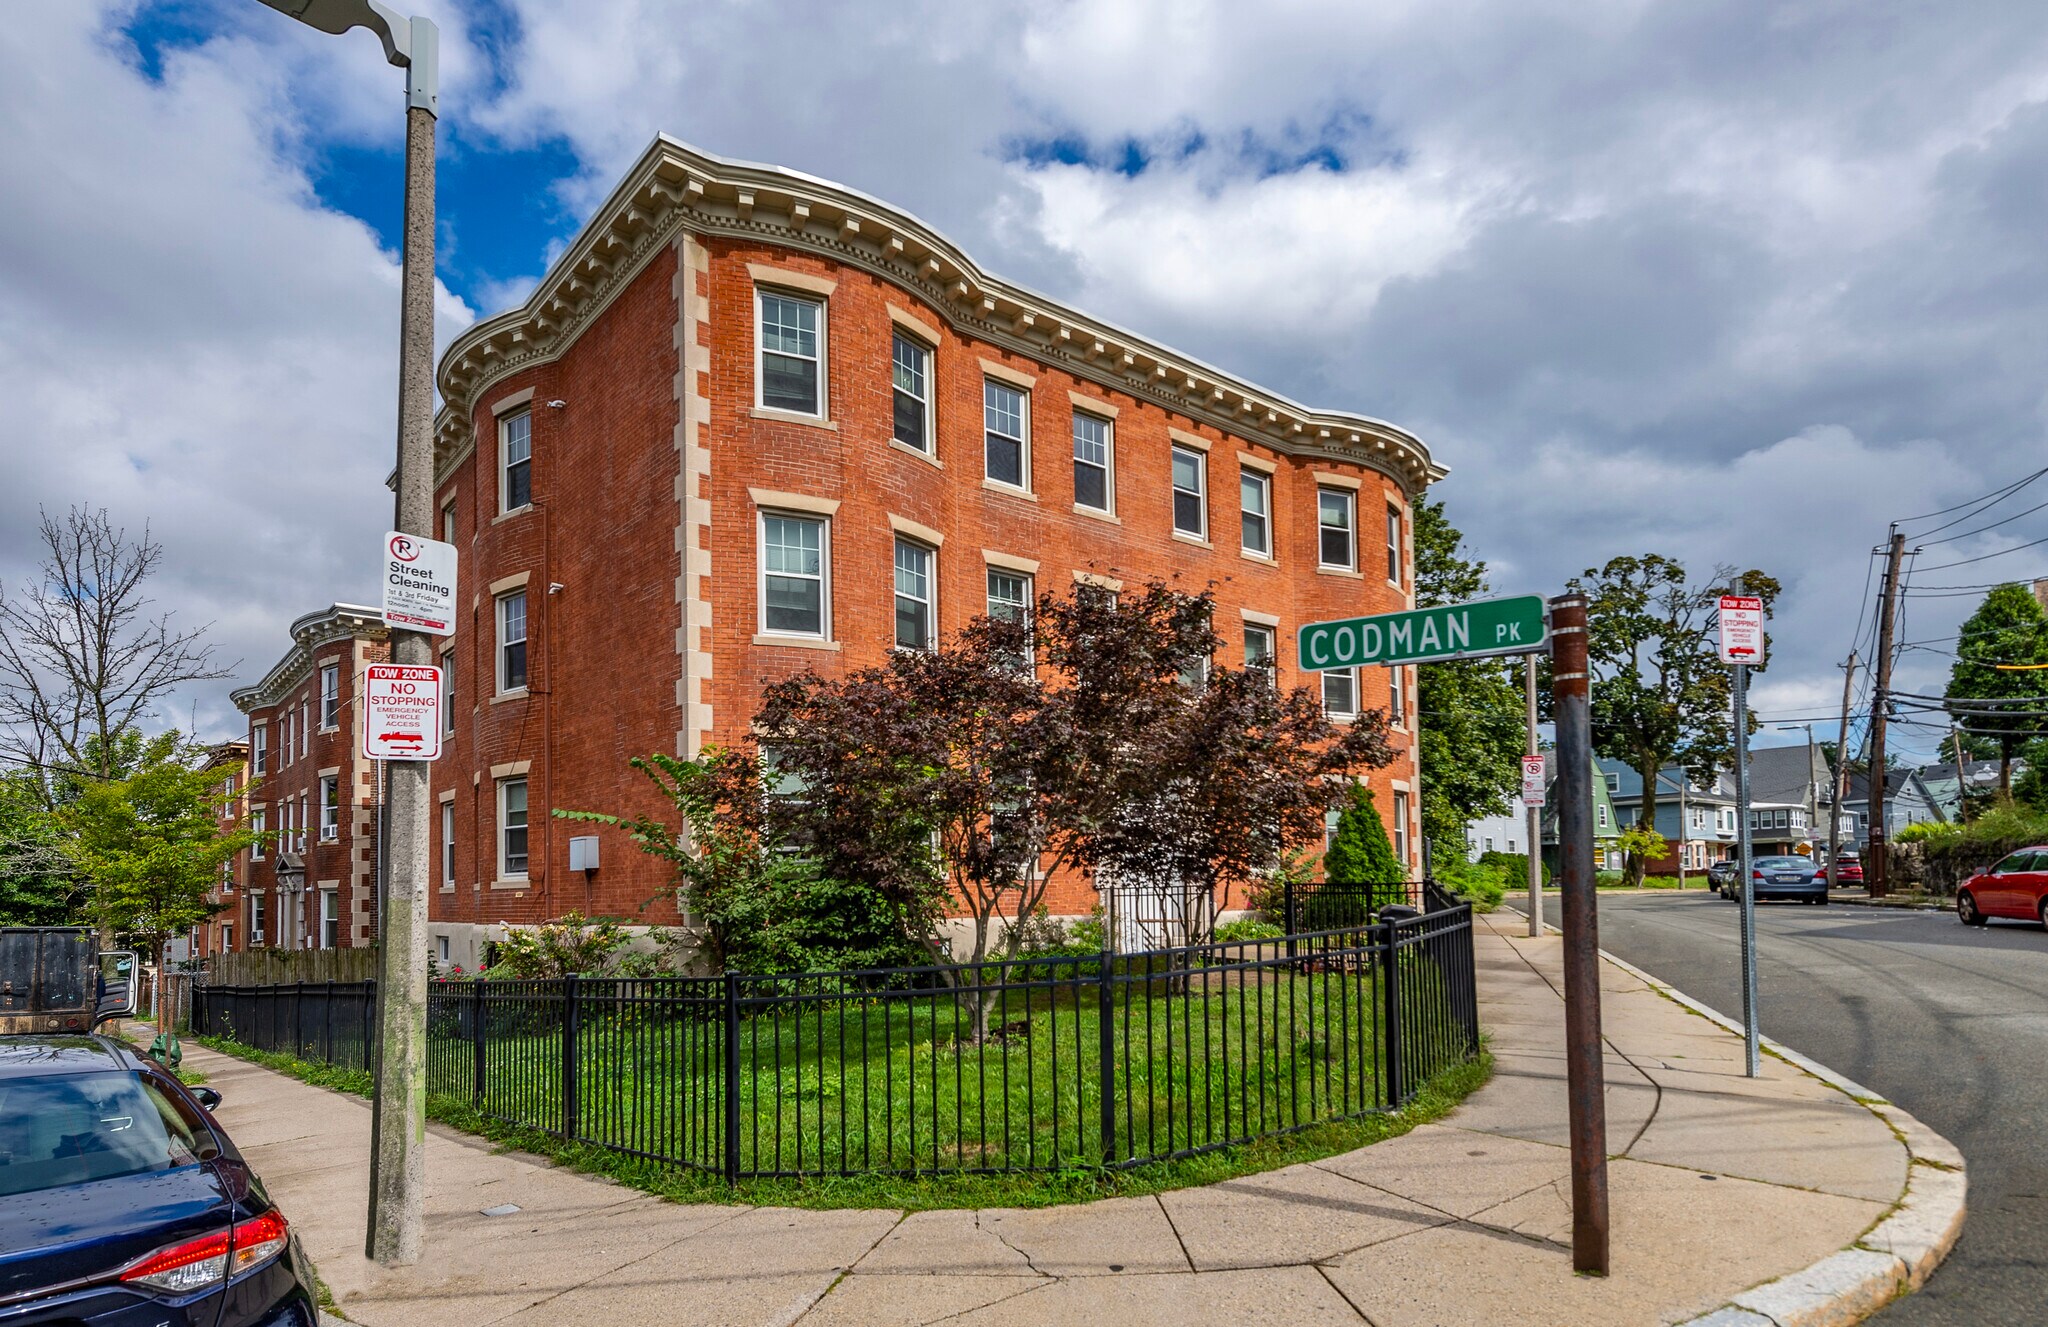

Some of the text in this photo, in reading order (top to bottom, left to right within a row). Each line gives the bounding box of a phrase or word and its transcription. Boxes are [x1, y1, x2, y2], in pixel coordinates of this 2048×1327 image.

[390, 561, 433, 580] Street
[389, 574, 449, 597] Cleaning
[416, 593, 439, 604] Friday
[1722, 599, 1761, 609] TOW ZONE
[389, 613, 405, 621] Tow
[406, 616, 426, 626] Zone
[1724, 619, 1758, 627] STOPPING
[1310, 611, 1522, 665] CODMAN PK
[372, 667, 434, 680] TOW ZONE
[390, 683, 416, 695] NO
[371, 695, 435, 706] STOPPING
